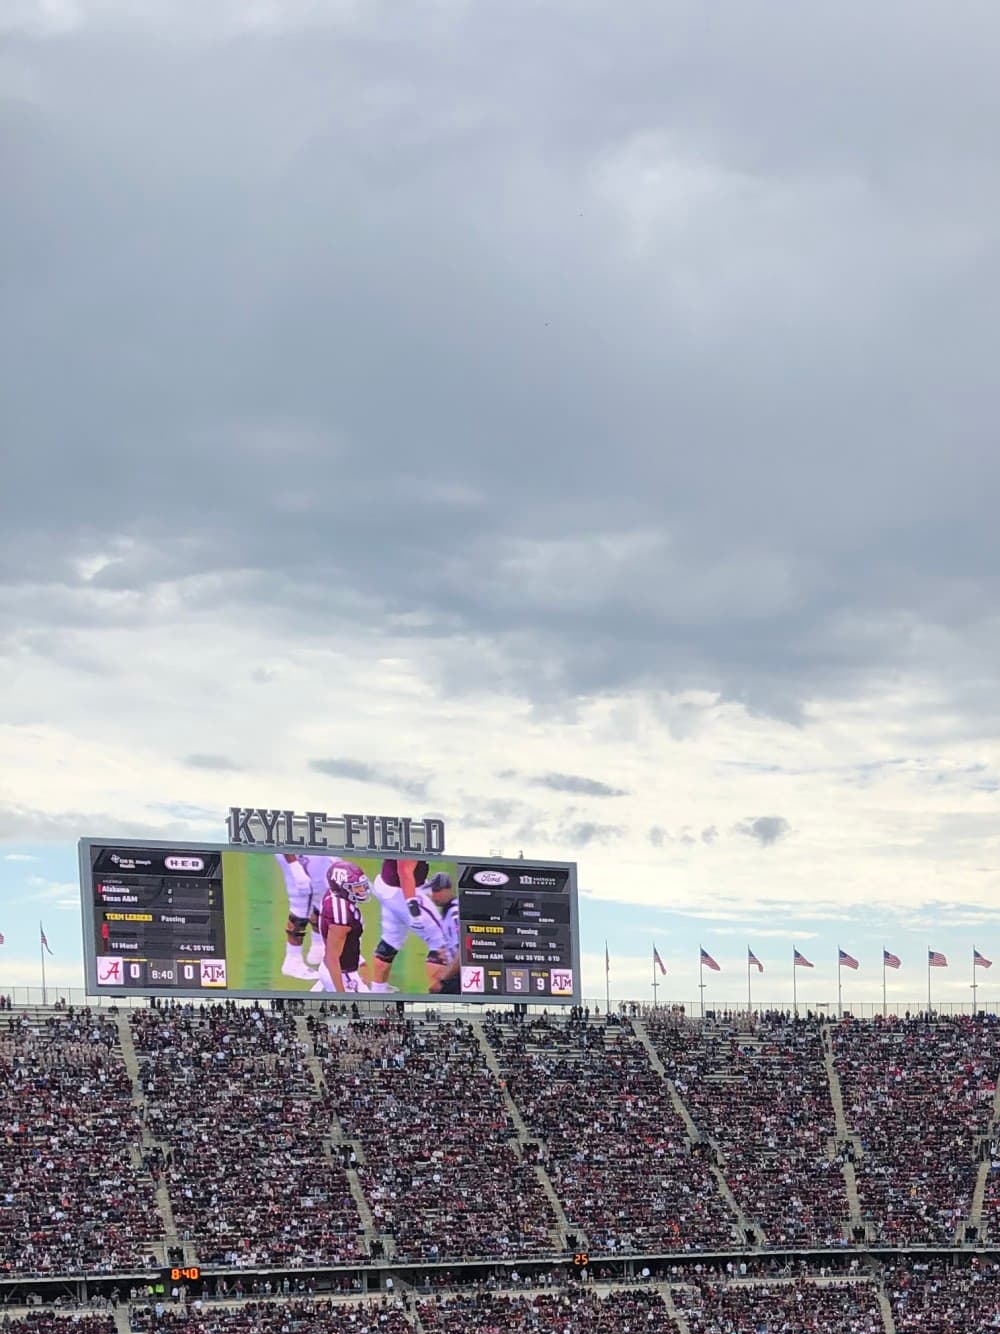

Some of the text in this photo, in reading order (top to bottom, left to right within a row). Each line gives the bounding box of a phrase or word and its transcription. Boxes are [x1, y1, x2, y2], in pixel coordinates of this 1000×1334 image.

[229, 807, 446, 855] KYLE FIELD
[480, 873, 502, 882] Ford
[102, 885, 130, 893] Alabama
[105, 913, 124, 921] TEAM
[161, 915, 186, 924] Passing
[486, 926, 504, 934] STATS
[517, 928, 539, 936] Passing
[130, 963, 140, 978] 0
[152, 970, 174, 980] 8:40
[184, 964, 194, 979] 0
[513, 977, 522, 990] 5
[537, 978, 545, 990] 9
[574, 1254, 588, 1265] 25
[171, 1268, 198, 1280] 8:40
